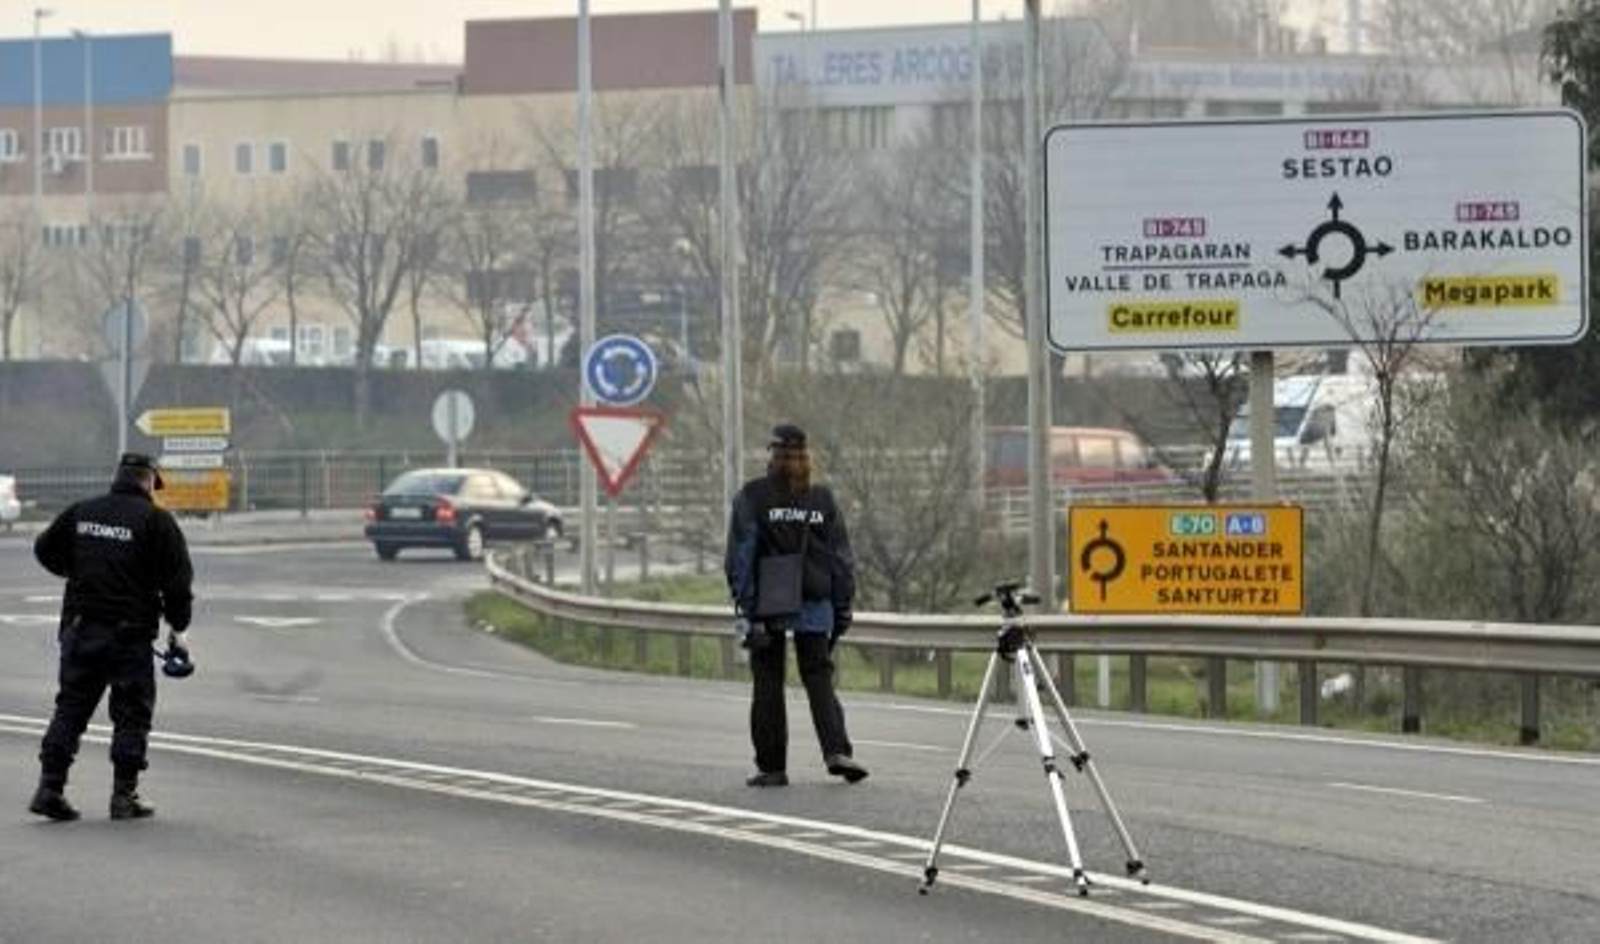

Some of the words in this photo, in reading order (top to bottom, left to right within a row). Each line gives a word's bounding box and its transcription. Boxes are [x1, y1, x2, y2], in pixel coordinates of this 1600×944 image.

[1283, 156, 1392, 178] SESTAO
[1404, 227, 1572, 251] BARAKALDO
[1102, 244, 1251, 262] TRAPAGARAN
[1065, 275, 1130, 291] VALLE
[1143, 274, 1172, 290] DE
[1186, 271, 1288, 289] TRAPAGA
[1424, 278, 1553, 306] Megapark
[1112, 304, 1235, 328] Carrefour
[1171, 514, 1215, 534] E-70
[1153, 542, 1283, 558] SANTANDER
[1141, 563, 1294, 581] PORTUGALETE
[1157, 587, 1279, 604] SANTURTZI
